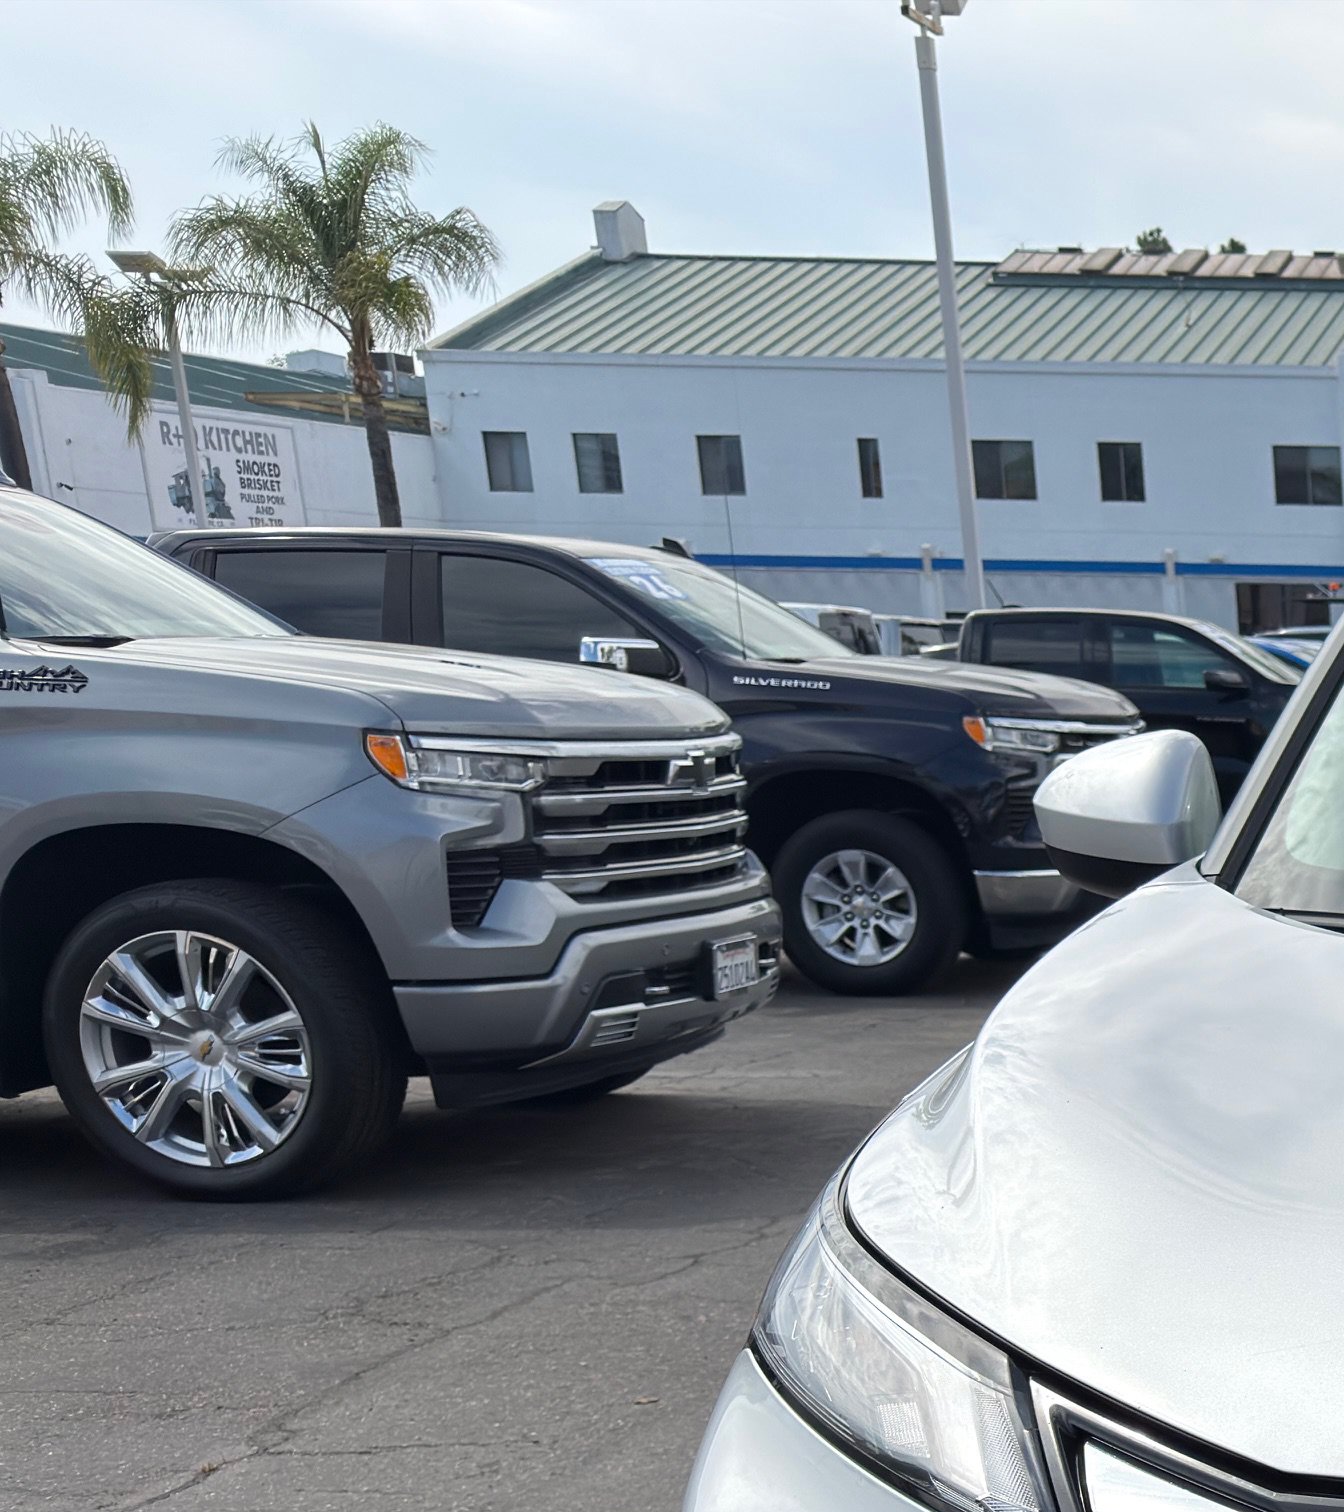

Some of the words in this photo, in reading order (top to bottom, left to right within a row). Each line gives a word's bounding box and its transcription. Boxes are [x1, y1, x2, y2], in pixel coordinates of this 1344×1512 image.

[202, 425, 278, 457] KITCHEN
[235, 459, 281, 478] SMOKED
[239, 477, 281, 492] BRISKET
[240, 493, 266, 504] PULLED
[266, 496, 285, 505] PORK
[255, 506, 275, 516] AND
[733, 676, 831, 690] SILVERADO
